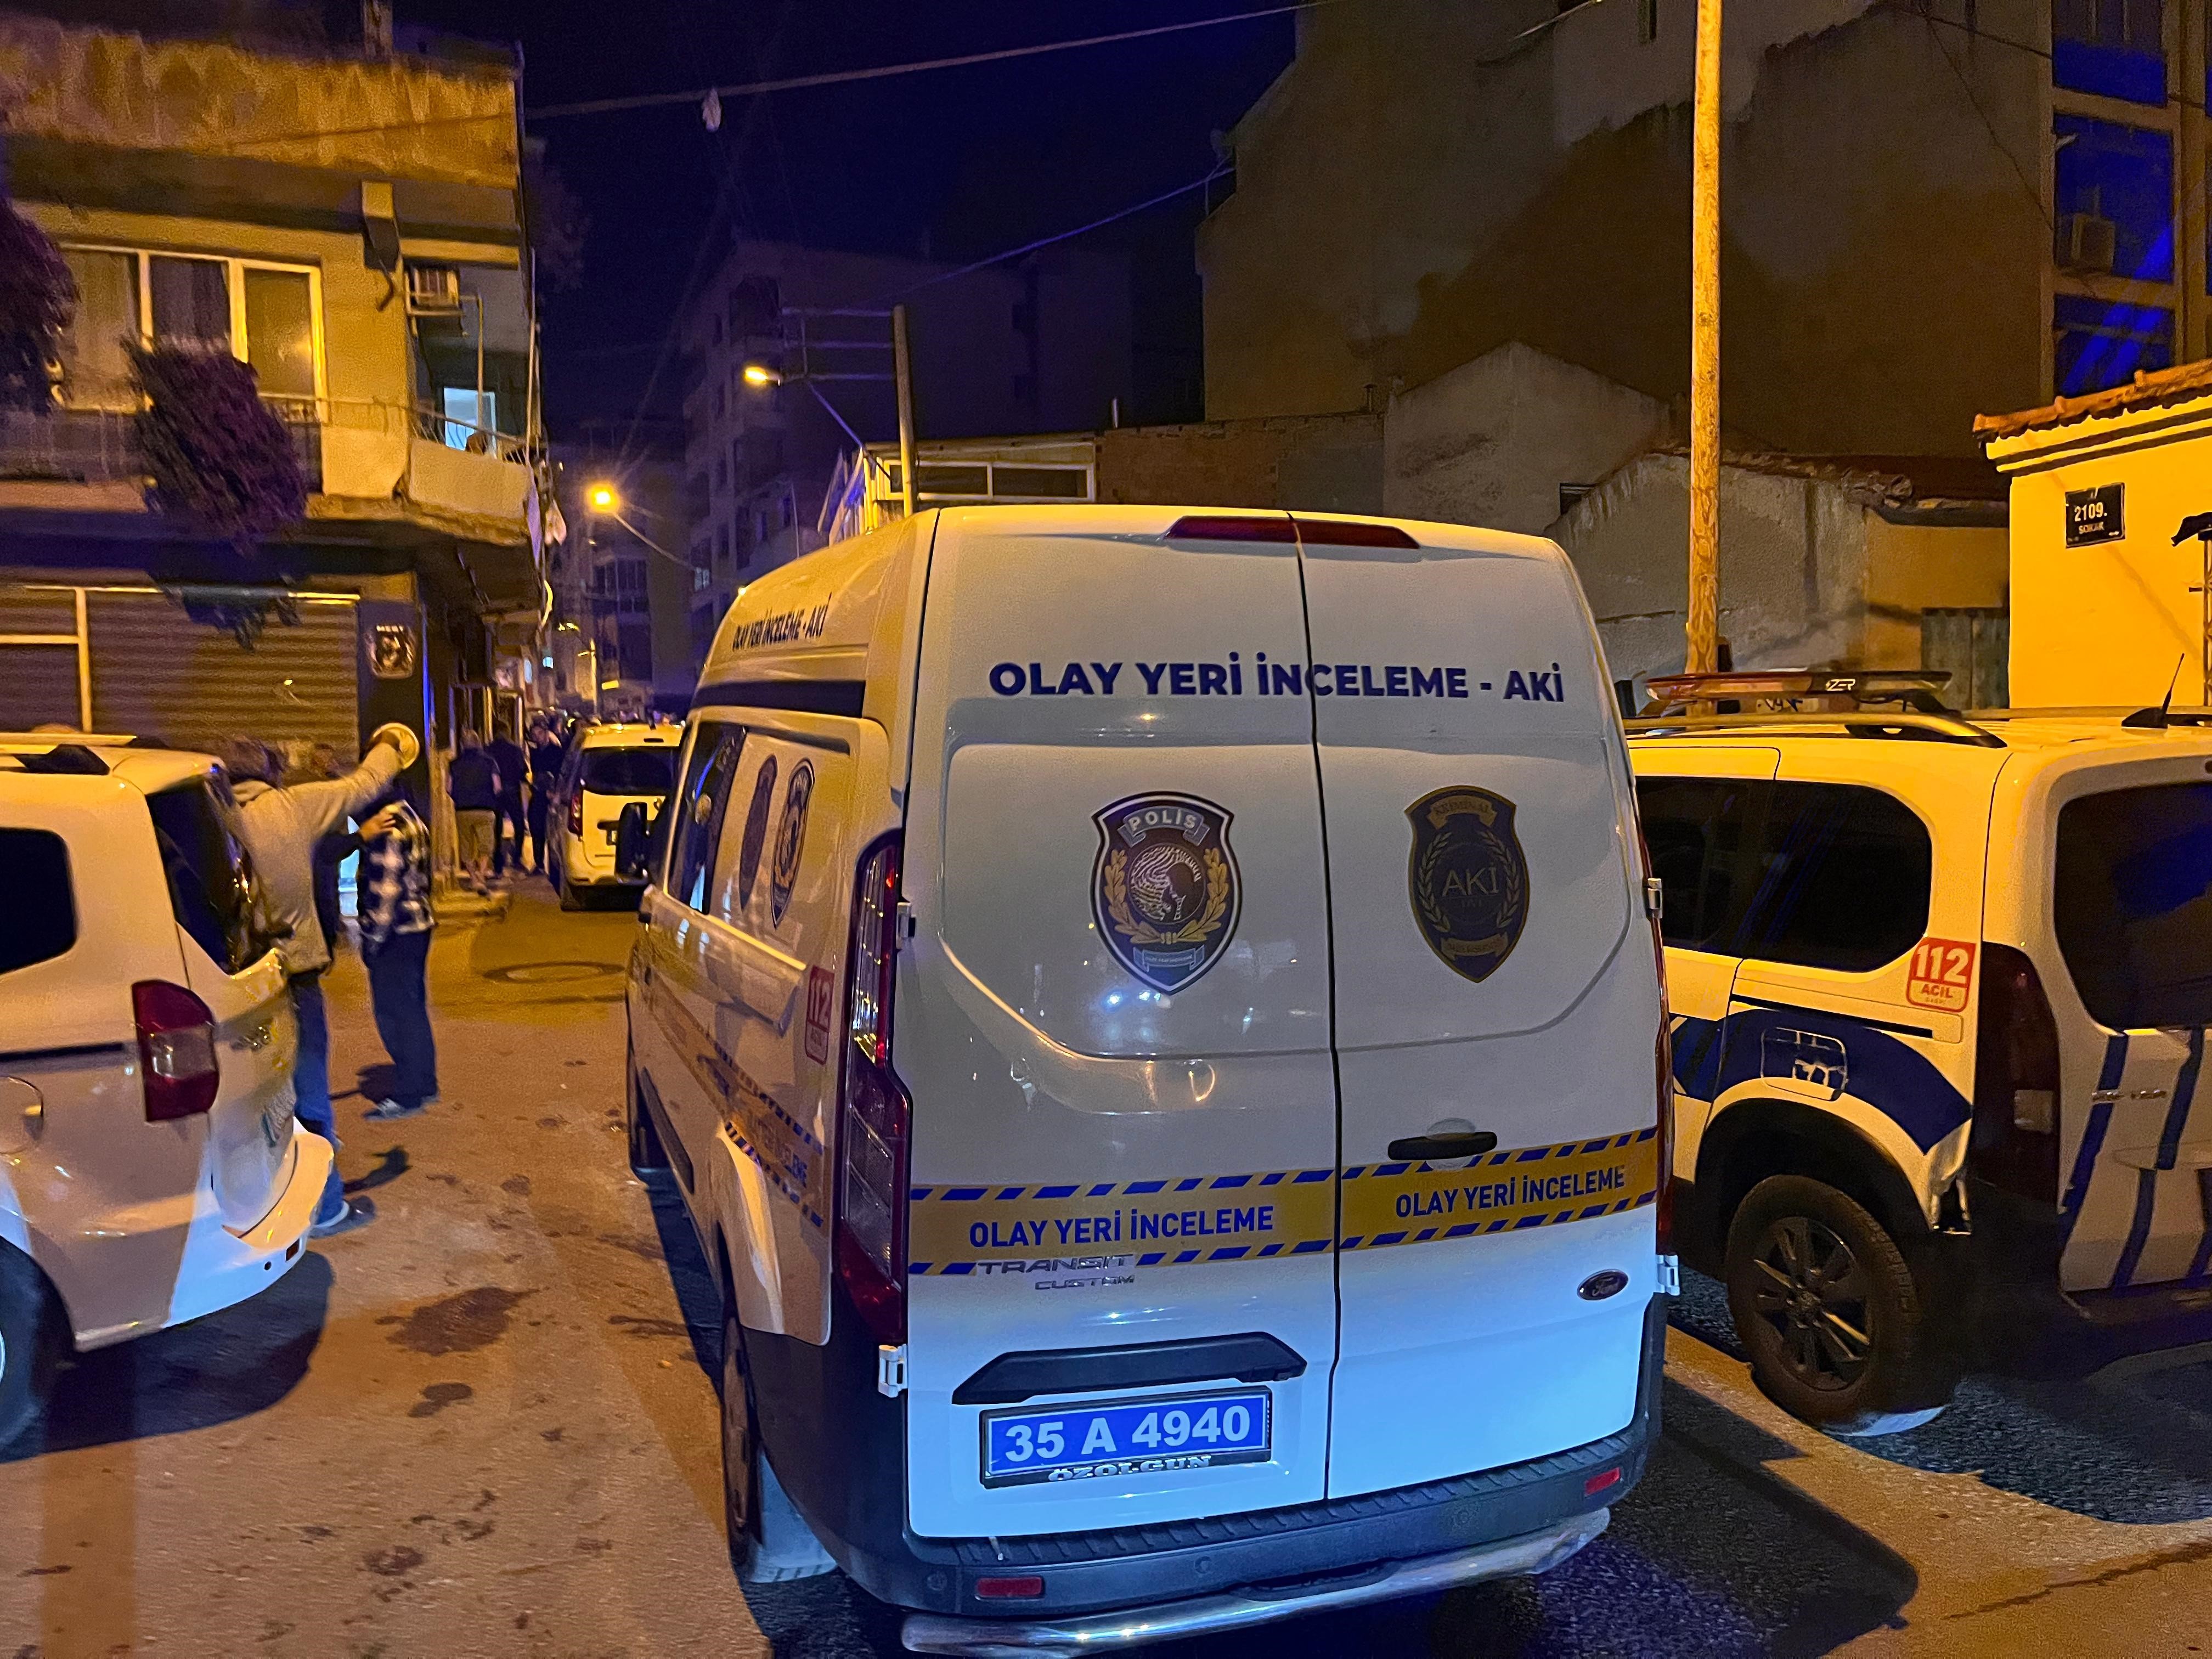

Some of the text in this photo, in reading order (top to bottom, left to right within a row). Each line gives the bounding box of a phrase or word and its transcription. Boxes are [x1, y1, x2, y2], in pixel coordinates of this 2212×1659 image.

[2074, 502, 2107, 522] 2109.
[989, 651, 1565, 702] OLAY YERİ İNCELEME - AKİ
[1128, 809, 1196, 831] POLİS
[1441, 862, 1499, 897] AKİ
[1915, 944, 1968, 984] 112
[809, 978, 831, 1028] 112
[1396, 1165, 1625, 1218] OLAY YERİ İNCELEME
[969, 1205, 1274, 1248] OLAY YERİ İNCELEME
[977, 1254, 1134, 1275] TRANSIT
[1035, 1274, 1136, 1290] CUSTOM
[1005, 1405, 1250, 1463] 35 A 4940
